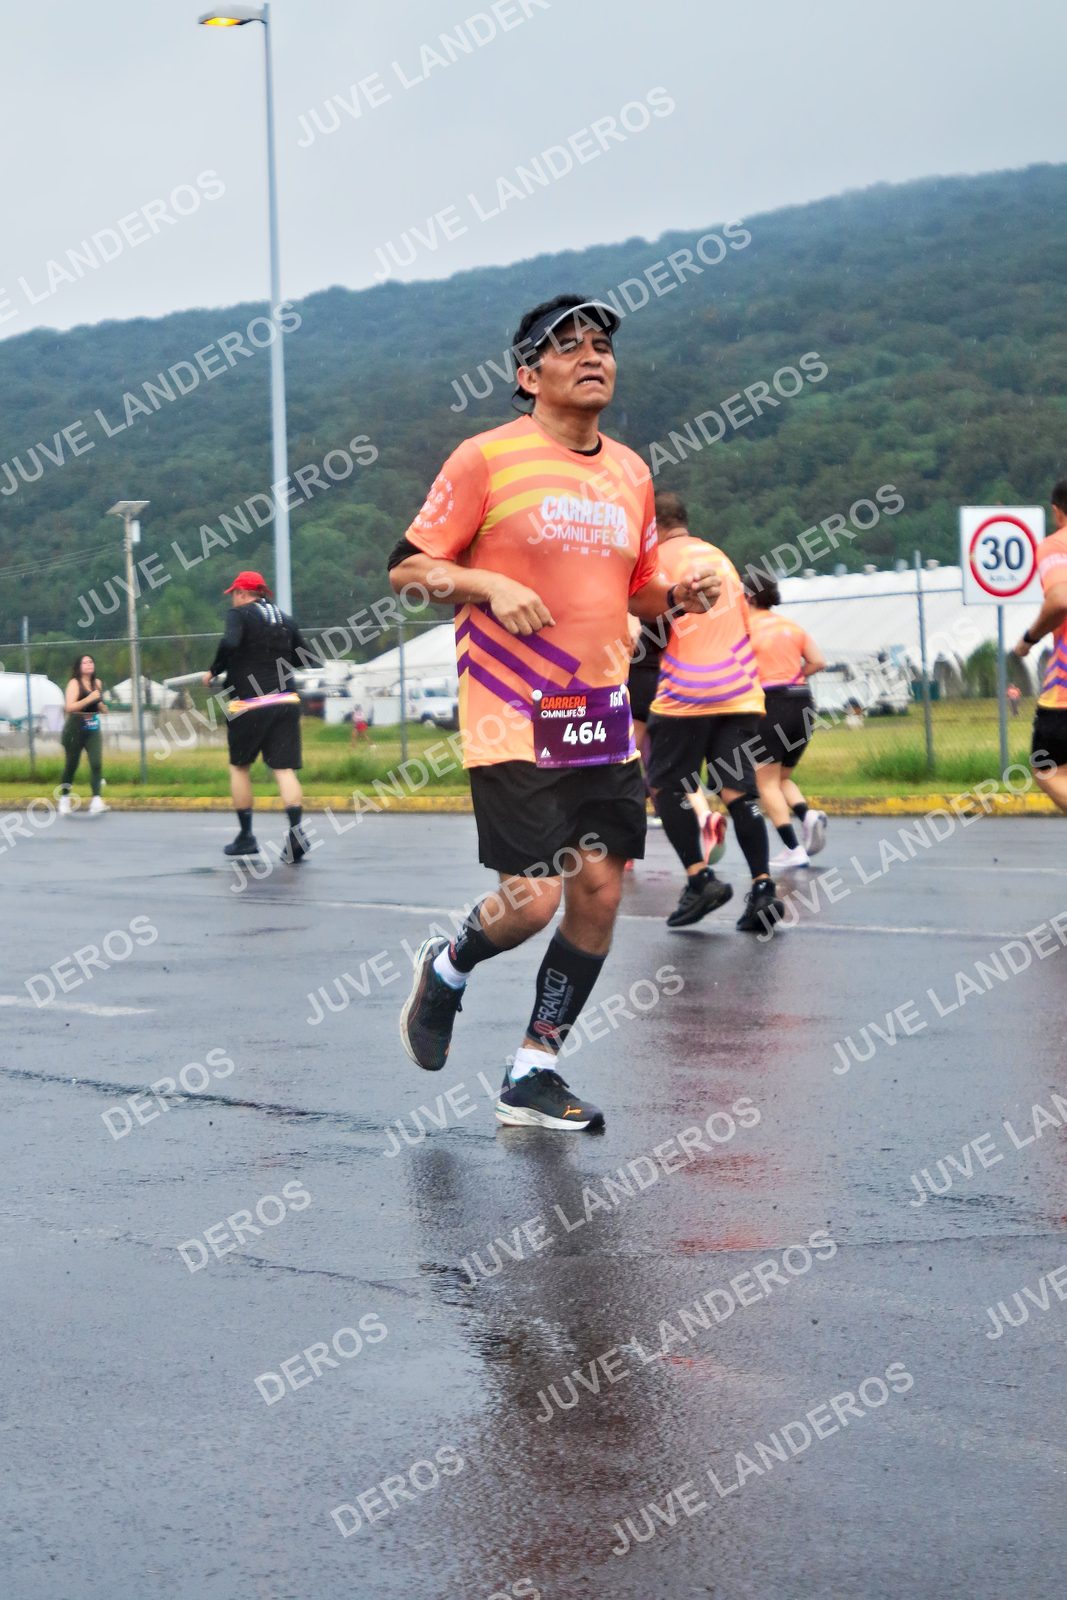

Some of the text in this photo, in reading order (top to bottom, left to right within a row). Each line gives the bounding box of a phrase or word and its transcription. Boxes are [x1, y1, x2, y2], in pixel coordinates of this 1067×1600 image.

[540, 495, 627, 529] CARRERA
[982, 536, 1025, 570] 30
[541, 696, 587, 709] CARRERA
[563, 721, 606, 745] 464
[537, 967, 569, 1024] FRANCO
